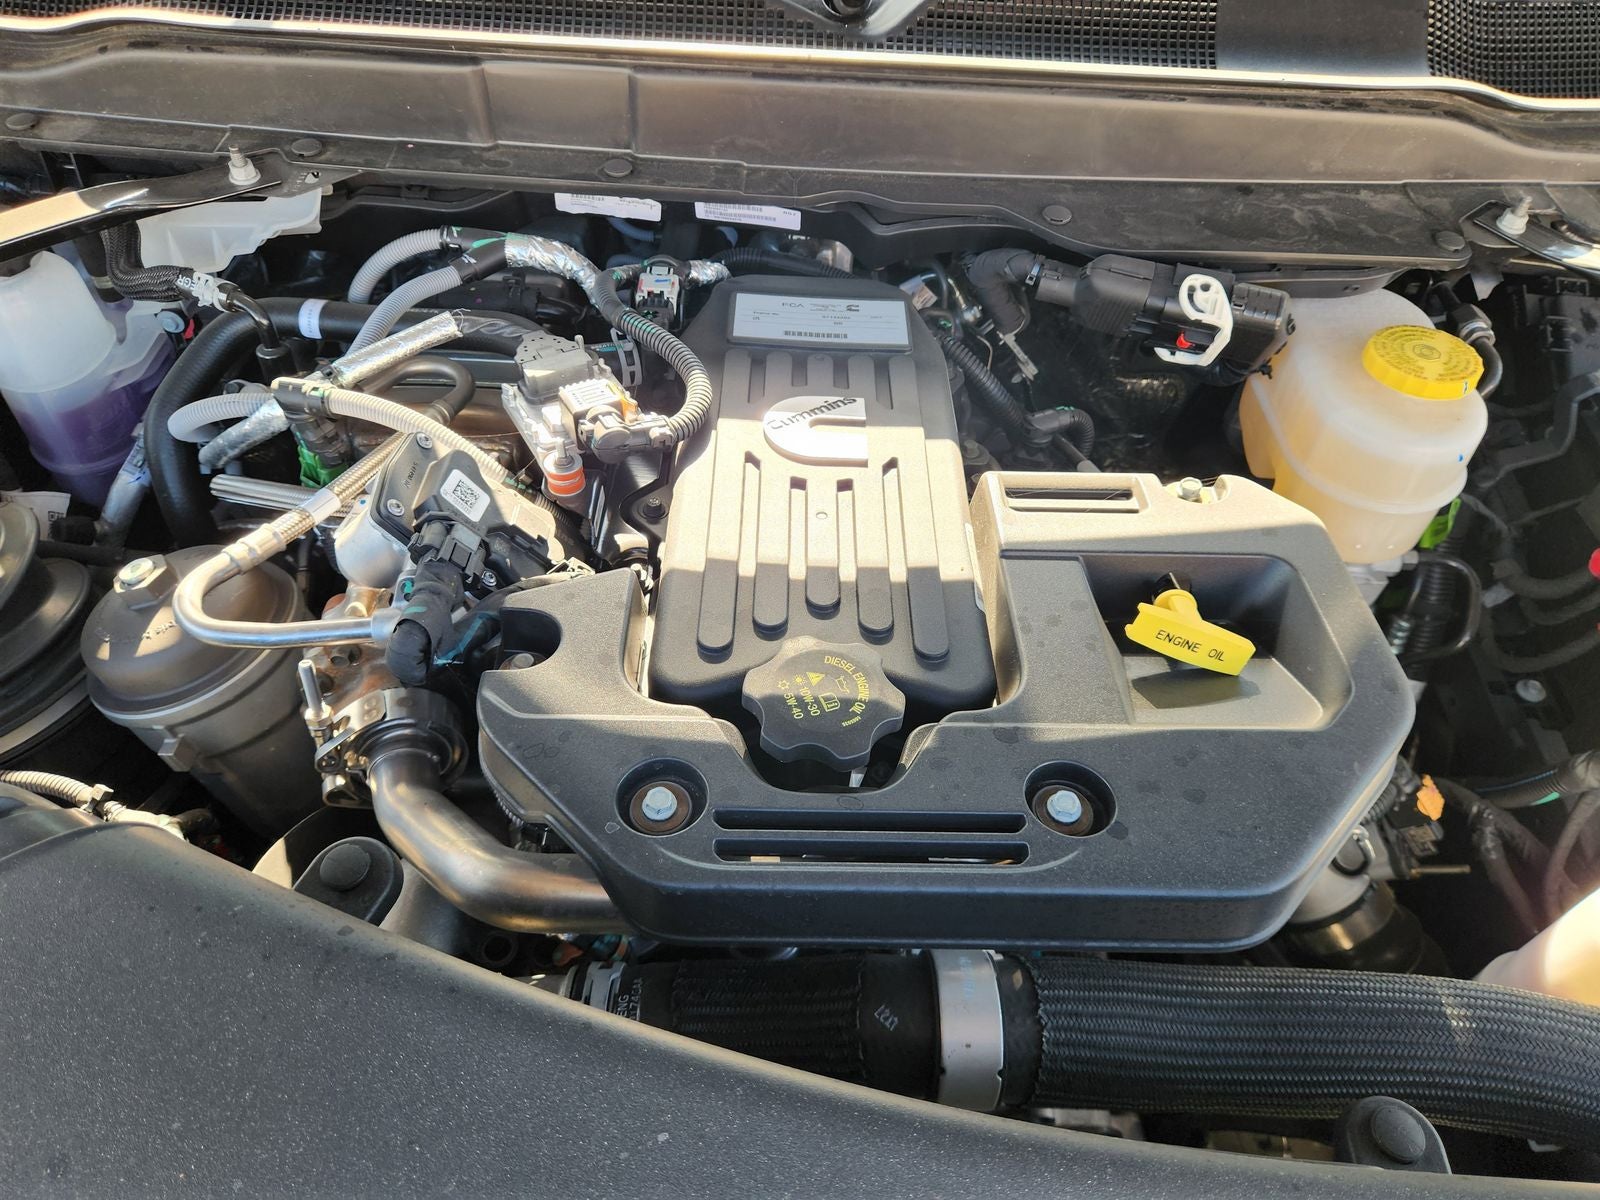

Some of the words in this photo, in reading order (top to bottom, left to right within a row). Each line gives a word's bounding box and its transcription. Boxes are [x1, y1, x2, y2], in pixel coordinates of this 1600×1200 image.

[766, 397, 857, 430] Cummins
[1155, 629, 1202, 653] ENGINE
[1207, 648, 1225, 662] OIL
[824, 655, 856, 675] DIESEL
[799, 686, 821, 717] 10W-30
[853, 672, 870, 703] ENGINE
[784, 692, 804, 719] 5W-40
[849, 701, 866, 714] OIL
